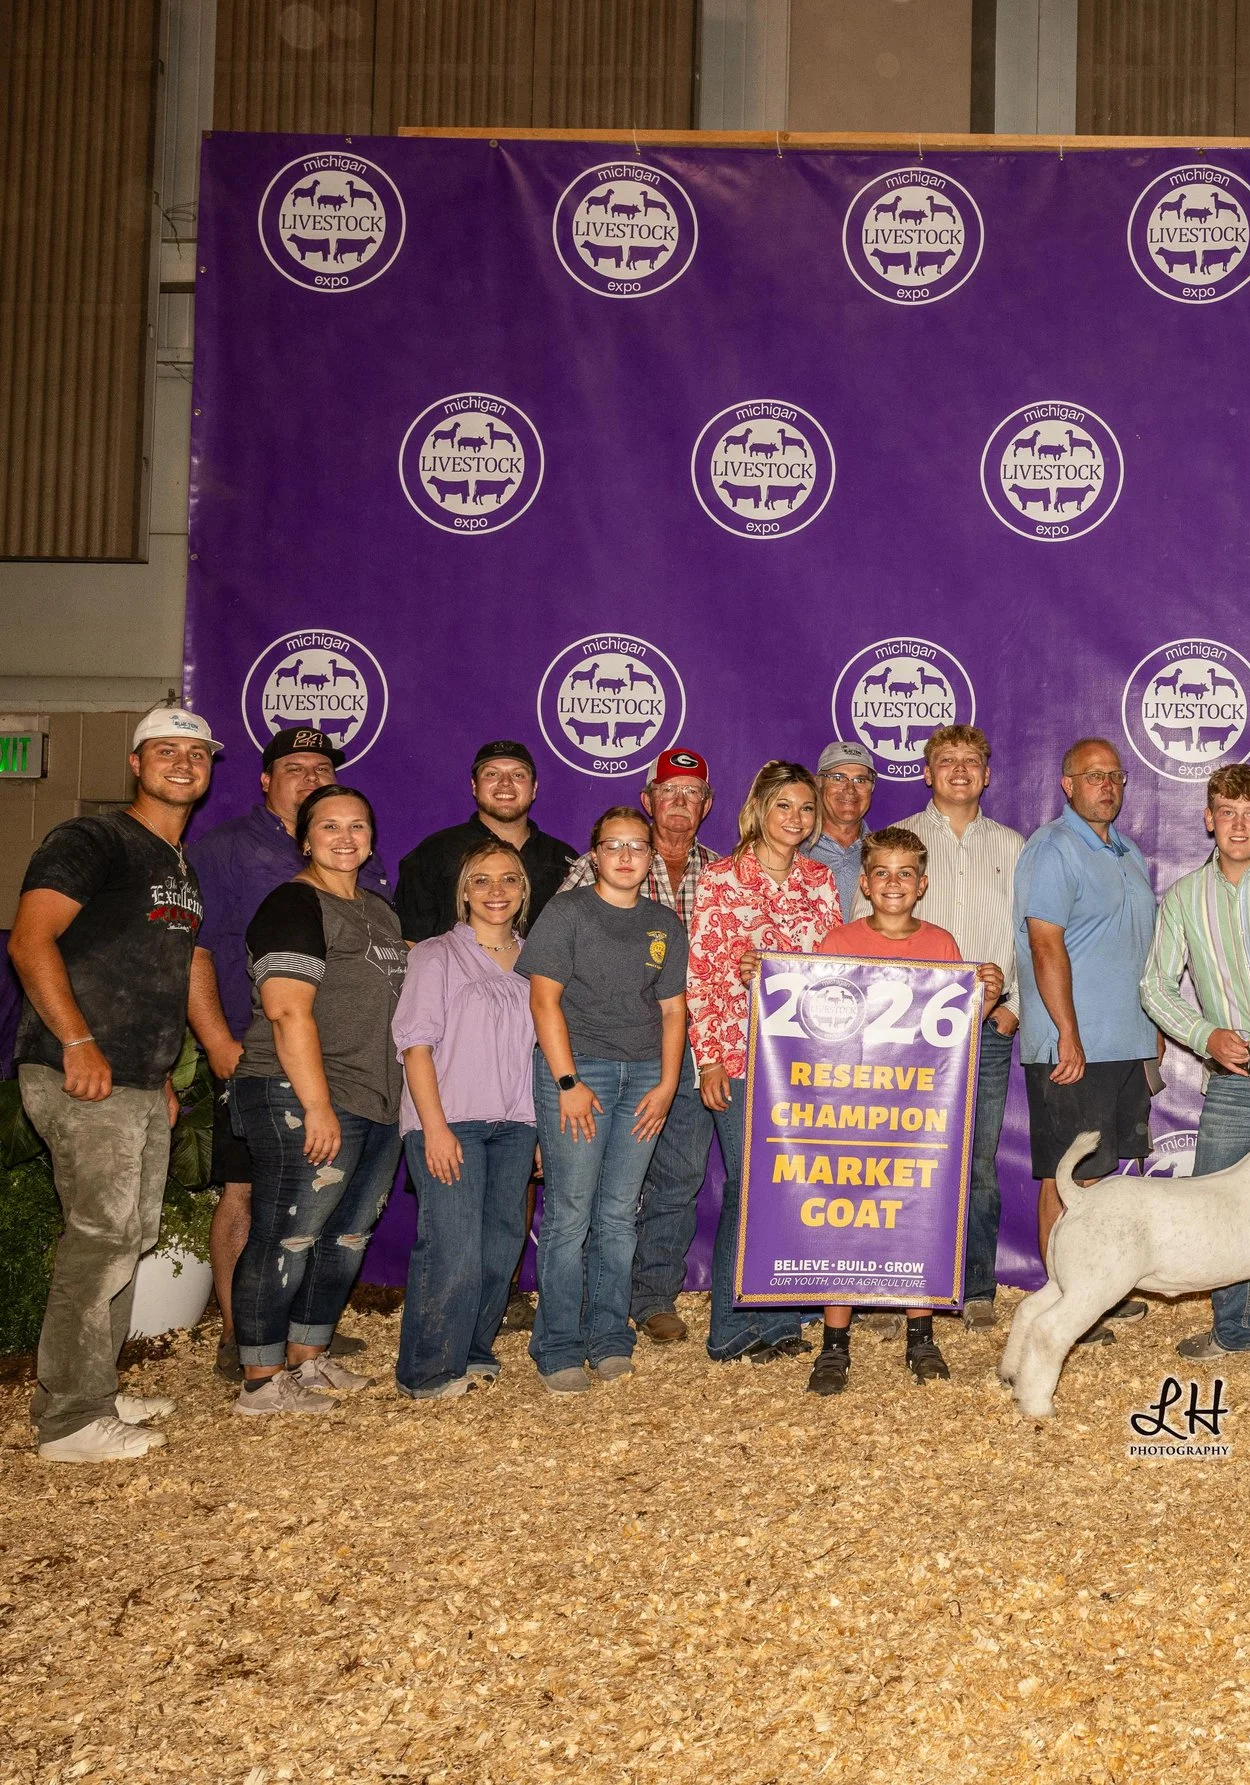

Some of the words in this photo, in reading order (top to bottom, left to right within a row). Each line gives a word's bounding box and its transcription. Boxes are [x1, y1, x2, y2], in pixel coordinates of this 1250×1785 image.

[303, 155, 367, 175] michigan
[597, 167, 661, 186] michigan
[885, 173, 946, 192] michigan
[1169, 168, 1230, 187] michigan
[281, 214, 383, 233] LIVESTOCK
[575, 221, 676, 241] LIVESTOCK
[864, 229, 962, 245] LIVESTOCK
[1149, 227, 1247, 244] LIVESTOCK
[315, 276, 348, 288] expo
[608, 282, 641, 294] expo
[897, 289, 929, 301] expo
[1183, 288, 1216, 301] expo
[443, 399, 507, 418] michigan
[735, 405, 798, 424] michigan
[1023, 404, 1085, 423] michigan
[421, 456, 522, 474] LIVESTOCK
[713, 461, 814, 479] LIVESTOCK
[1002, 465, 1102, 481] LIVESTOCK
[454, 518, 487, 530] expo
[746, 523, 779, 536] expo
[1036, 525, 1069, 538] expo
[286, 636, 351, 655] michigan
[582, 640, 647, 659] michigan
[874, 644, 937, 663] michigan
[1165, 642, 1228, 661] michigan
[264, 695, 365, 711] LIVESTOCK
[559, 698, 663, 716] LIVESTOCK
[853, 701, 954, 719] LIVESTOCK
[1144, 703, 1245, 720] LIVESTOCK
[293, 730, 323, 748] 24
[0, 736, 32, 772] XIT
[594, 760, 627, 773] expo
[887, 763, 920, 776] expo
[1178, 765, 1212, 779] expo
[150, 884, 203, 921] Excellen
[790, 1061, 936, 1091] RESERVE
[771, 1101, 948, 1132] CHAMPION
[1160, 1134, 1198, 1152] michi
[772, 1154, 939, 1188] MARKET
[800, 1197, 903, 1229] GOAT
[773, 1259, 830, 1271] BELIEVE
[836, 1260, 877, 1272] BUILD
[884, 1261, 925, 1274] GROW
[769, 1277, 791, 1286] OUR
[794, 1276, 830, 1287] YOUTH,
[832, 1277, 855, 1286] OUR
[856, 1277, 927, 1289] AGRICULTURE
